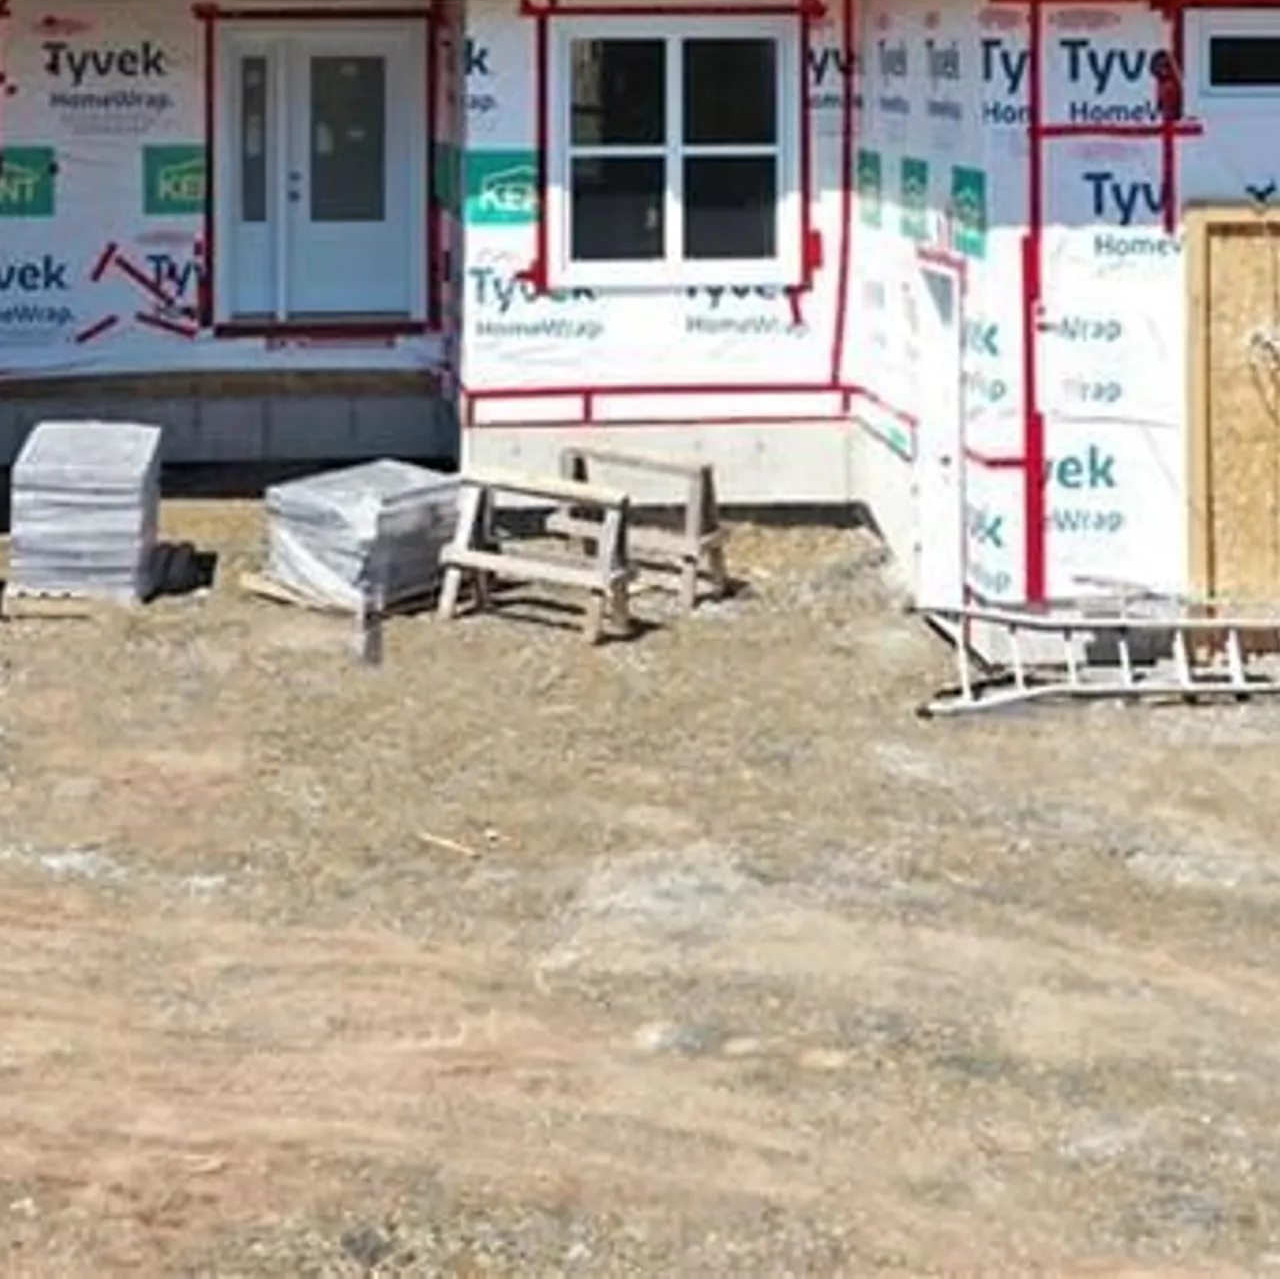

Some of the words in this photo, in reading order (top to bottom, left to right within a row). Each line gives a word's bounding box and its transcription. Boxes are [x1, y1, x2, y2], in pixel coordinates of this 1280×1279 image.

[41, 41, 167, 88] Tyvek
[981, 38, 1031, 95] Ty
[1059, 38, 1170, 95] Tyve
[1082, 172, 1168, 226] Tyv
